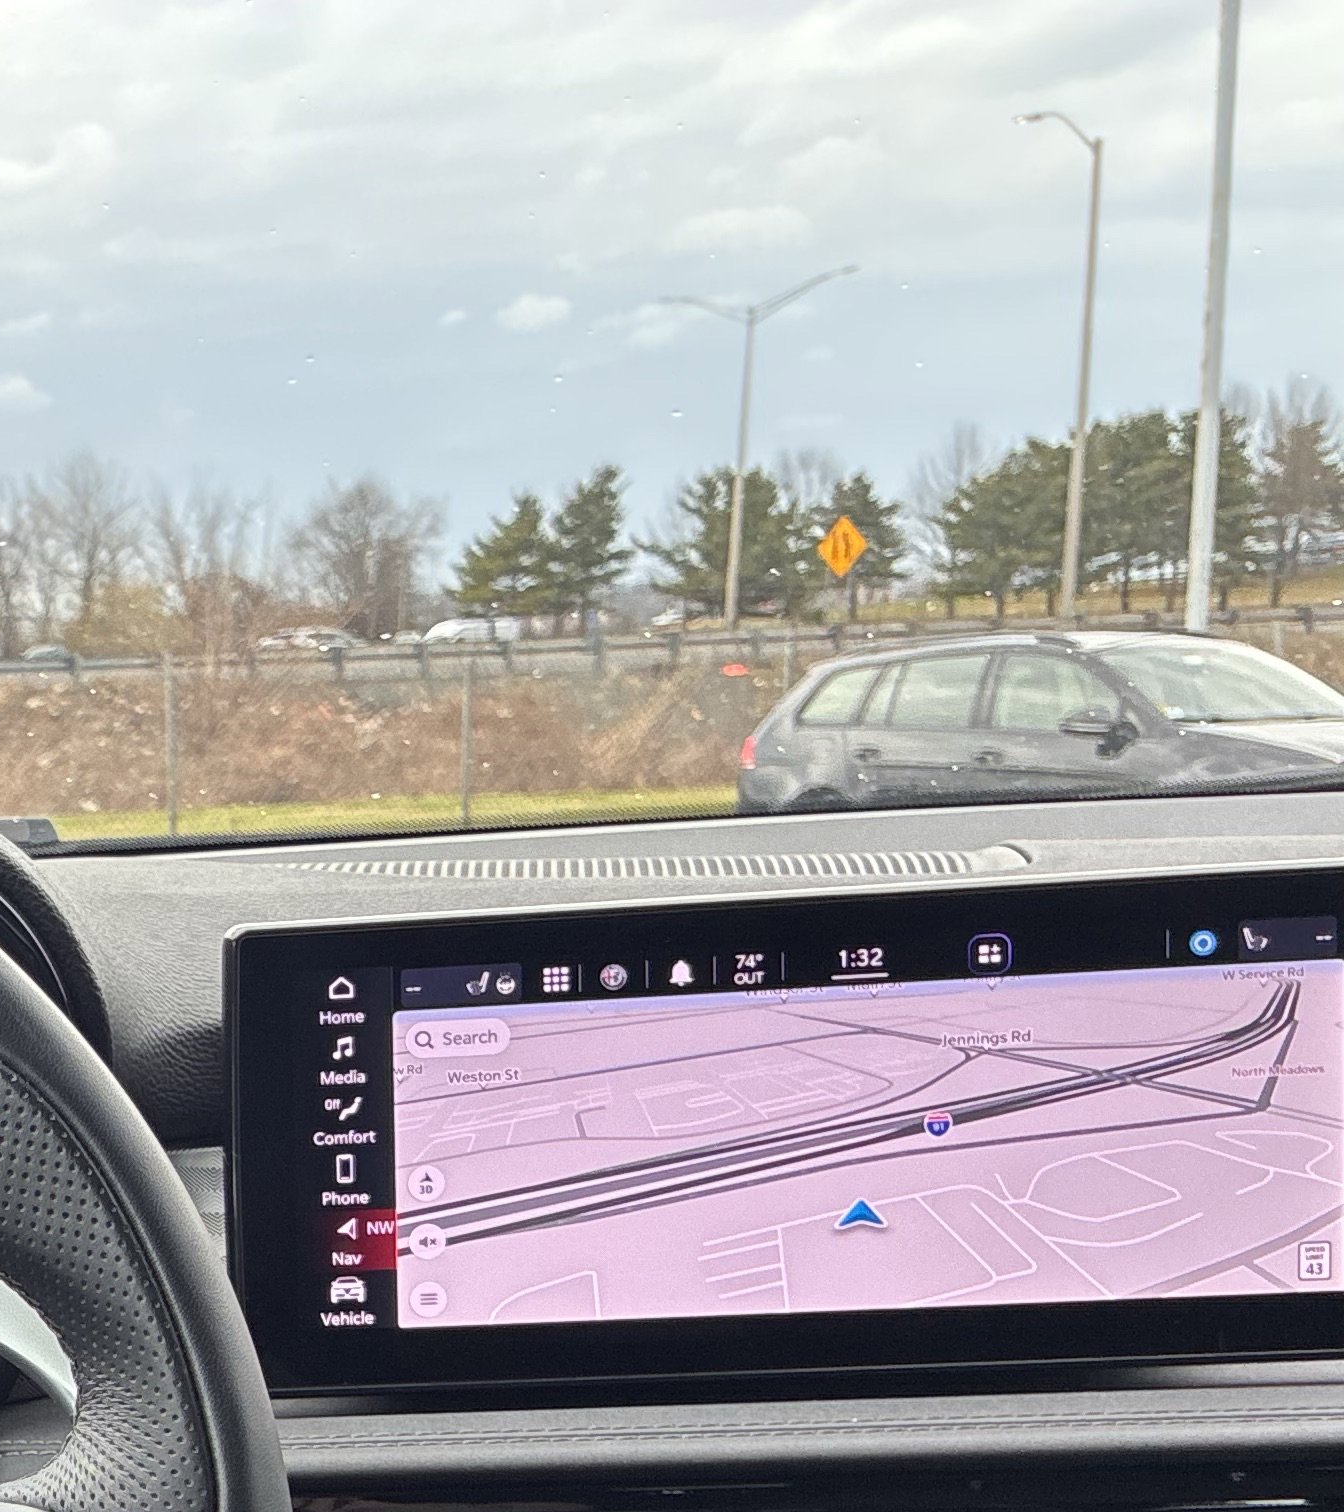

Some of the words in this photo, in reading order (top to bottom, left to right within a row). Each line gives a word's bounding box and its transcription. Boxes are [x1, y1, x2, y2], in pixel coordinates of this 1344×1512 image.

[838, 948, 883, 968] 1:32
[733, 971, 764, 986] OUT
[1238, 967, 1285, 980] Service
[1287, 966, 1305, 978] Rd
[319, 1010, 365, 1025] Home
[443, 1029, 498, 1046] Search
[942, 1032, 1008, 1048] Jennings
[1011, 1030, 1031, 1043] Rd
[320, 1070, 366, 1086] Media
[447, 1069, 501, 1084] Weston
[504, 1068, 519, 1081] St
[1232, 1067, 1266, 1077] North
[1269, 1065, 1325, 1075] Meadows
[324, 1098, 341, 1111] Off
[313, 1129, 377, 1146] Comfort
[419, 1184, 434, 1195] 3D
[322, 1191, 370, 1206] Phone
[366, 1220, 395, 1236] NW
[332, 1251, 363, 1266] Nav
[1305, 1262, 1323, 1276] 43
[320, 1311, 375, 1327] Vehicle
